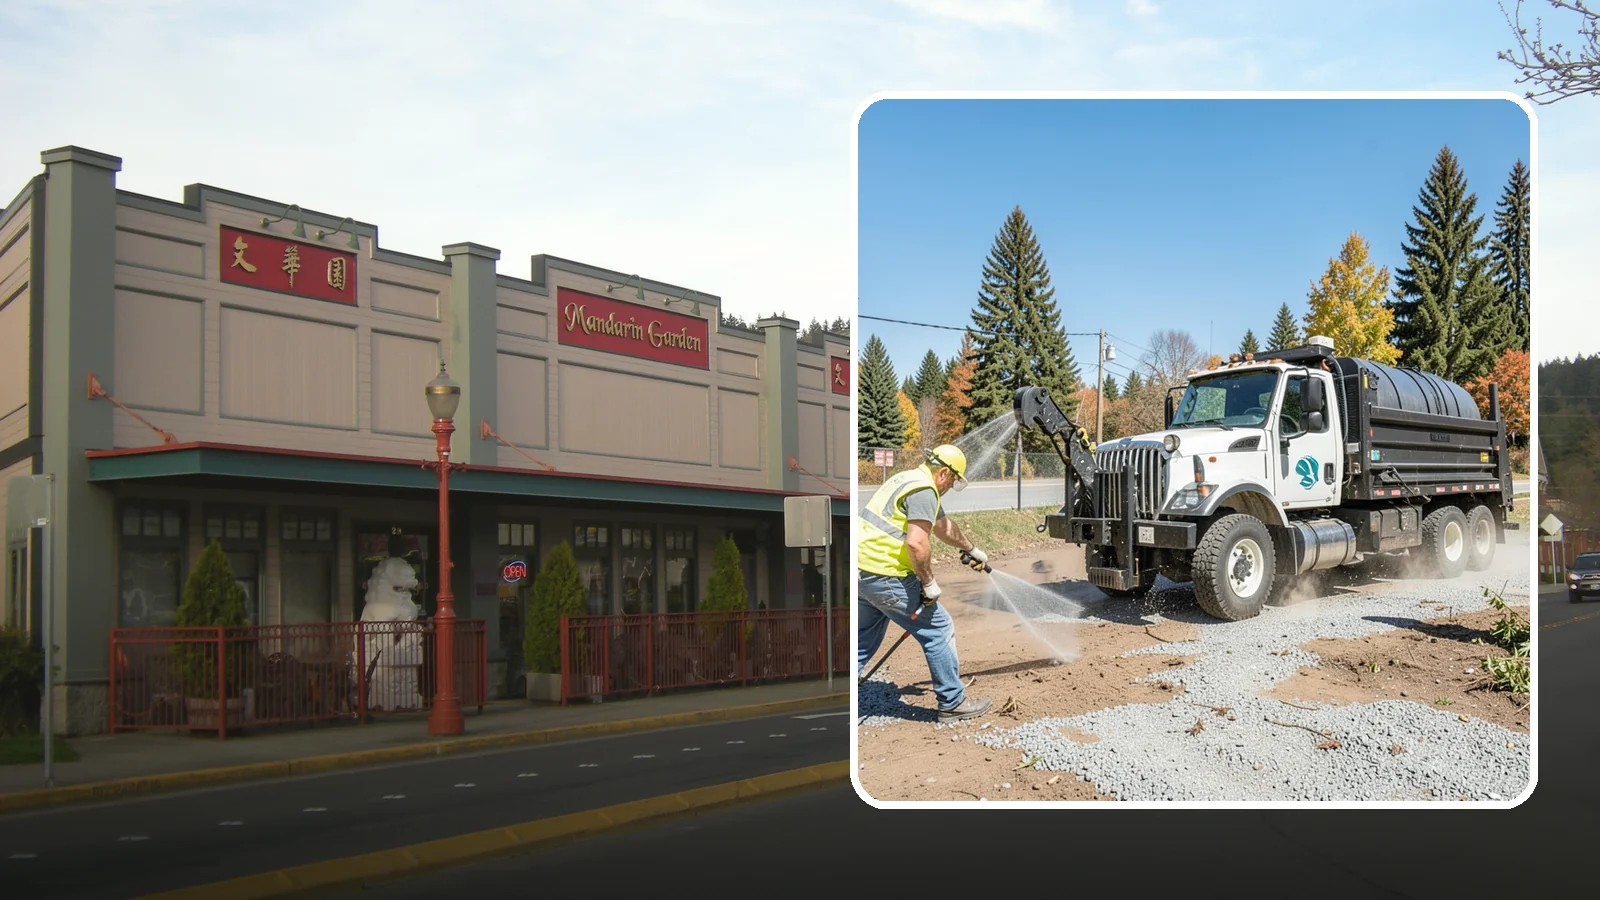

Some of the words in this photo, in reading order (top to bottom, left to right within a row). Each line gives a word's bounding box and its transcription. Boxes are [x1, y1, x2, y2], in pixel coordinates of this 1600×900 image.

[231, 236, 345, 290] 文華園
[564, 302, 644, 341] Mandarin
[647, 320, 701, 352] Garden
[503, 565, 527, 578] OPEN
